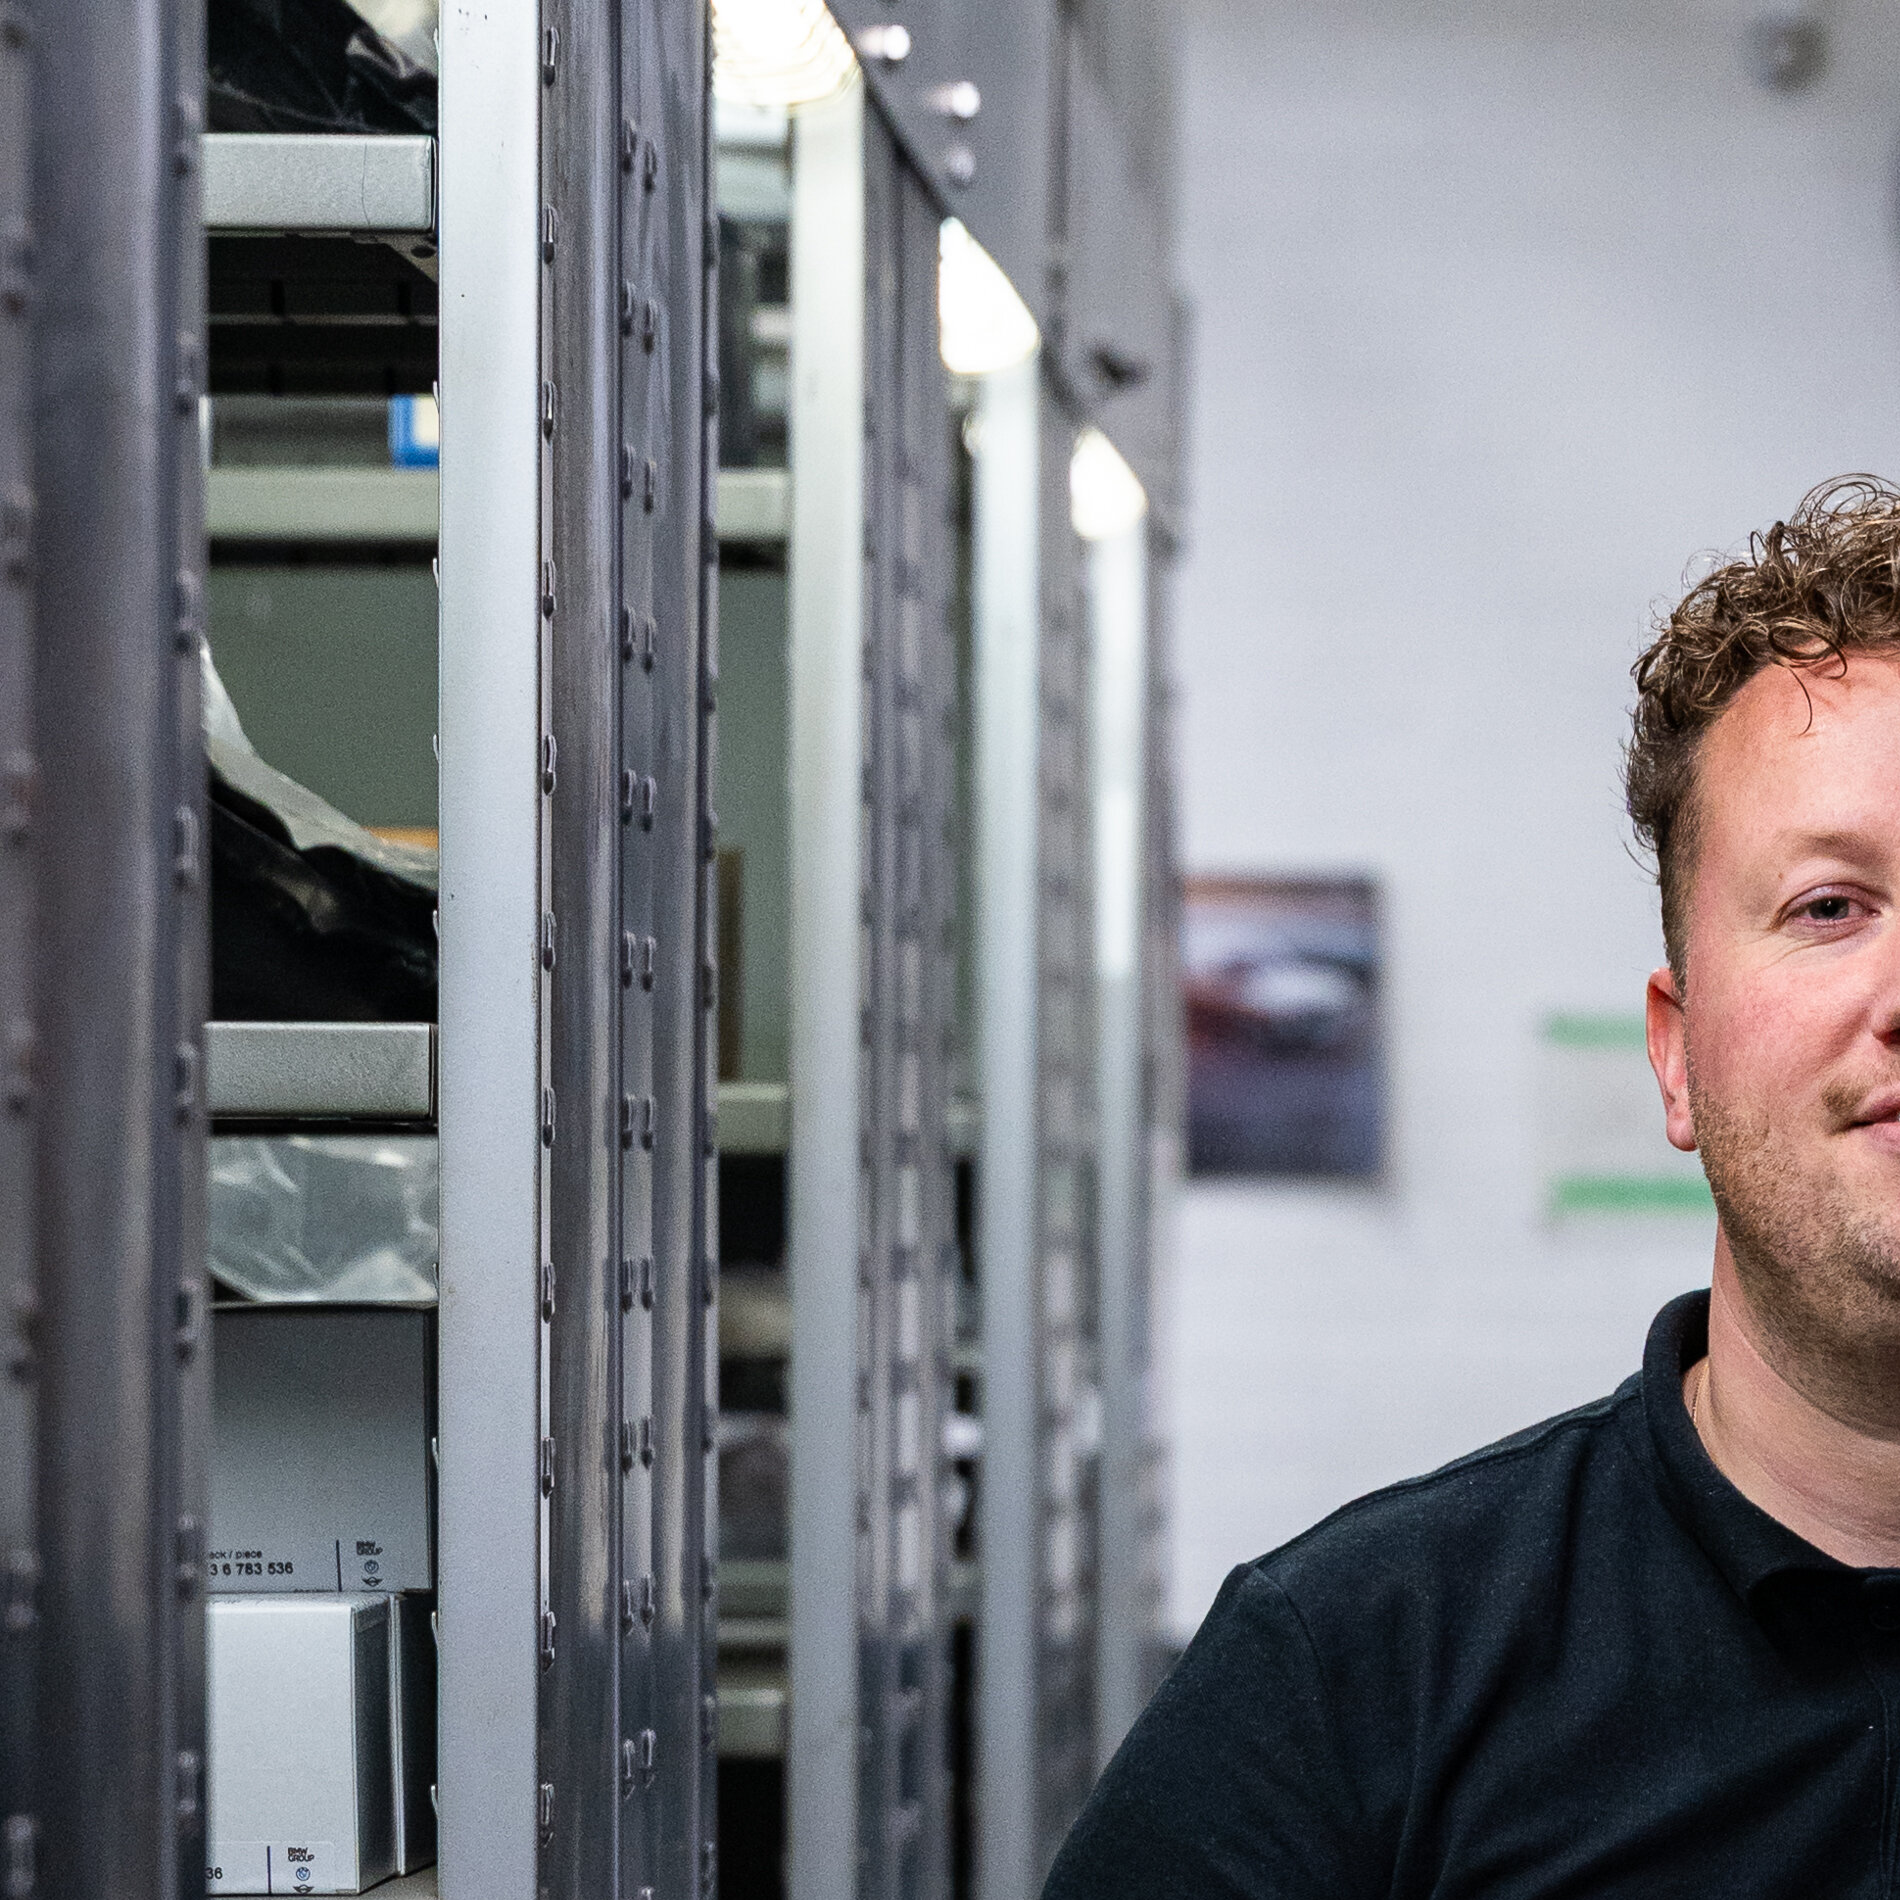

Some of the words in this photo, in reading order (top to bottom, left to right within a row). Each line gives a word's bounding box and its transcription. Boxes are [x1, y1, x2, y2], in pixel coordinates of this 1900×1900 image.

[235, 1562, 263, 1576] 783
[267, 1561, 294, 1575] 536
[287, 1847, 308, 1855] BMW
[287, 1854, 315, 1862] GROUP
